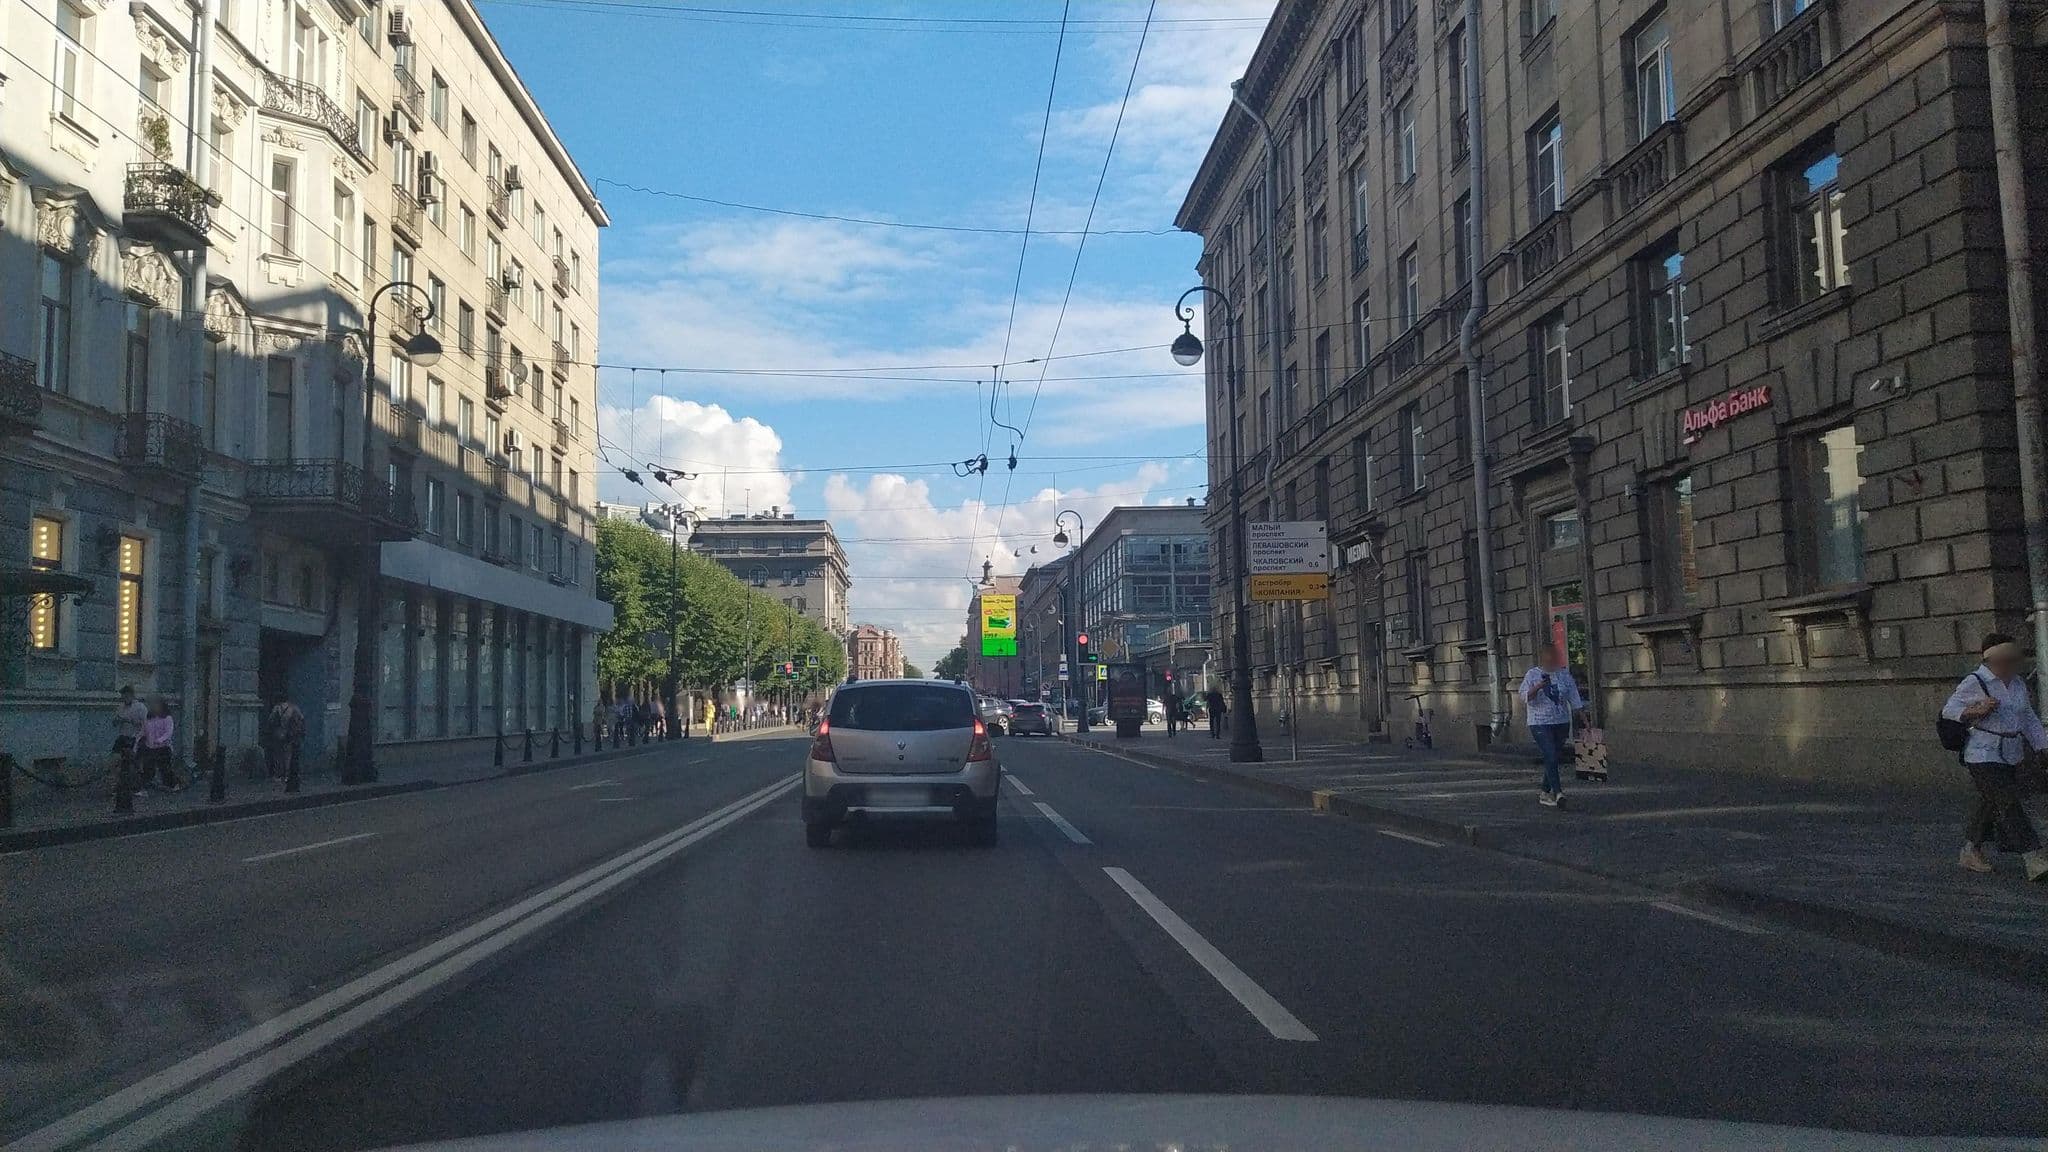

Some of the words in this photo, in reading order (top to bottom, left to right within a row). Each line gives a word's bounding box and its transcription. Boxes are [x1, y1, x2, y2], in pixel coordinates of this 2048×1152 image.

[1683, 400, 1728, 434] Альфа
[1728, 385, 1768, 417] Банк
[1252, 523, 1281, 531] МАЛЫЙ
[1252, 531, 1285, 539] проспект
[1252, 541, 1309, 549] ЛЕВАШОВСКИЙ
[1253, 557, 1304, 565] ЧКАЛОВСКИЙ
